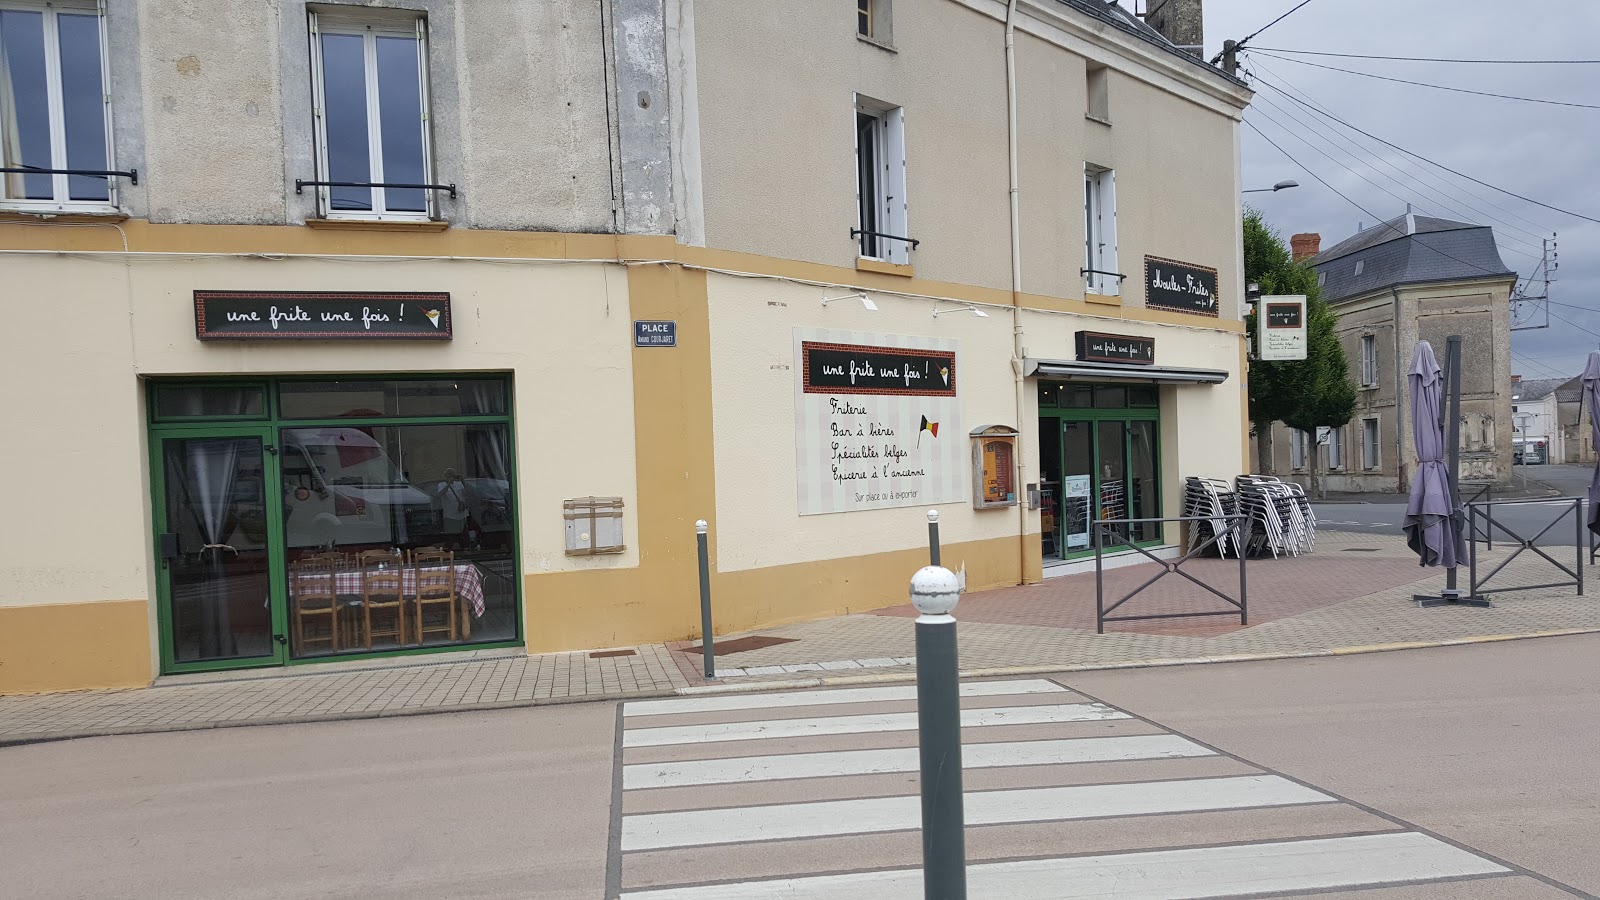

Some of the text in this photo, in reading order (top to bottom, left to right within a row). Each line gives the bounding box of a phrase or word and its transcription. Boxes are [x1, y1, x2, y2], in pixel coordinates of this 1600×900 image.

[1152, 268, 1209, 297] Moules-Frites
[227, 303, 405, 330] une frite une fois !
[641, 324, 669, 333] PLACE
[1104, 341, 1117, 357] frite
[1129, 343, 1138, 358] fois
[822, 359, 929, 387] une frite une fois !
[829, 397, 867, 415] Friterie
[830, 421, 895, 437] Bar à bières
[830, 441, 908, 465] Spécialités belges
[831, 463, 868, 485] Epicerie
[870, 465, 878, 479] à
[854, 492, 865, 503] Sur
[866, 491, 880, 503] place
[881, 493, 889, 501] ou
